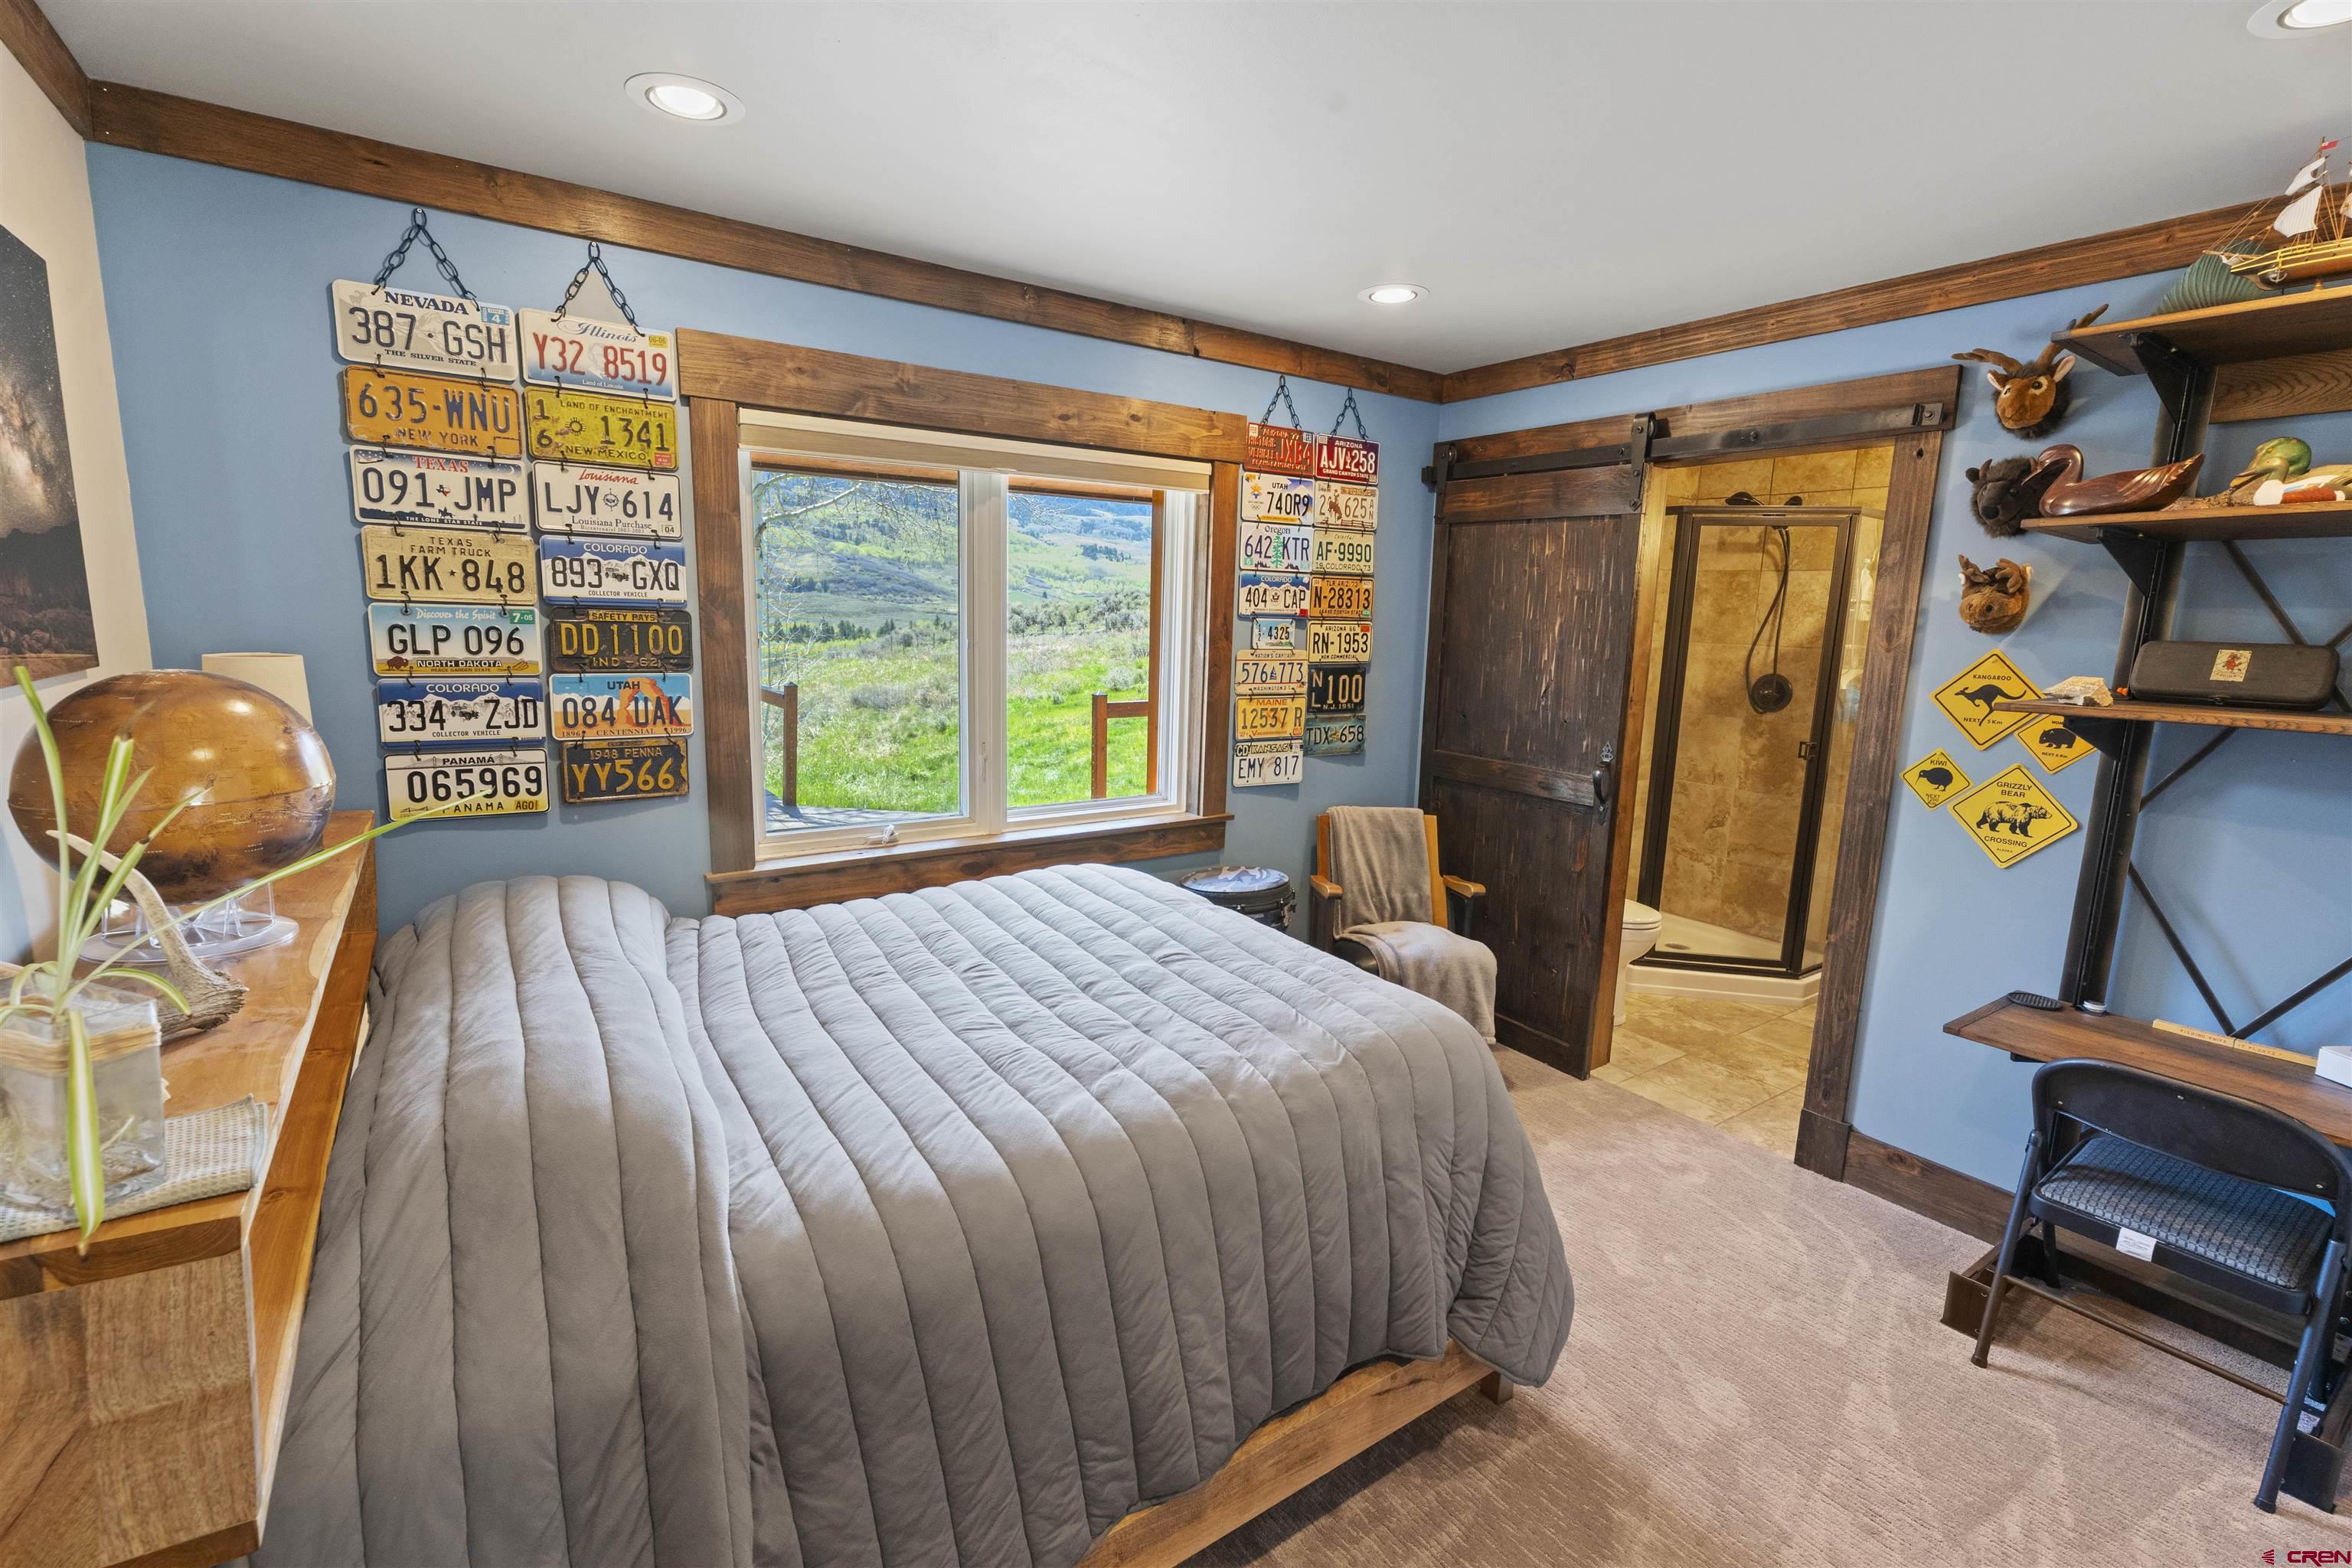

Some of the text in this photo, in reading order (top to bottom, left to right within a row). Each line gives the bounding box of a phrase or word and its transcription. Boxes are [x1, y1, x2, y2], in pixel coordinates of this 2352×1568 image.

[384, 291, 469, 315] NEVADA
[349, 306, 507, 363] 387 GSH
[557, 320, 638, 343] Illinois
[410, 353, 444, 361] SILVER
[448, 358, 477, 367] STATE
[533, 332, 667, 386] Y32 8519
[560, 400, 585, 410] LAND
[604, 405, 668, 419] ENCHANTMENT
[397, 428, 479, 446] NEW YORK
[600, 416, 671, 452] 1341
[1335, 440, 1363, 449] ARIZONA
[565, 446, 593, 456] NEW
[599, 448, 647, 460] MEXICO
[1320, 446, 1346, 470] AJV
[1351, 449, 1376, 473] 258
[413, 456, 469, 473] TEXAS
[579, 469, 639, 485] Louisiana
[362, 467, 517, 512] 091 JMP
[544, 482, 674, 521] LJY 614
[1344, 497, 1367, 518] 625
[571, 515, 652, 530] Louisiana Purchase
[1265, 525, 1291, 535] Oregon
[410, 544, 492, 557] FARM TRUCK
[430, 536, 472, 547] TEXAS
[583, 543, 648, 554] COLORADO
[1245, 534, 1309, 560] 642 KTR
[375, 554, 525, 593] 1KK 848
[550, 557, 680, 591] 893 GXQ
[1246, 587, 1305, 609] 404 CAP
[1314, 586, 1370, 609] N-28313
[416, 607, 496, 621] Discover the Spirit
[387, 623, 524, 655] GLP 096
[1268, 626, 1289, 640] 4325
[1312, 632, 1368, 654] RN-1953
[593, 657, 620, 667] IND
[1242, 662, 1303, 684] 576 773
[426, 684, 499, 692] COLORADO
[606, 681, 640, 690] UTAH
[1327, 675, 1363, 704] 100
[387, 699, 538, 731] 334 ZJD
[562, 695, 682, 728] 084 UAK
[1242, 707, 1302, 730] 12537 R
[1306, 724, 1364, 745] TDX 658
[443, 754, 495, 765] PANAMÁ
[590, 747, 662, 760] 1948 PENNA
[1236, 743, 1290, 756] CD KANSAS
[571, 757, 675, 792] YY566
[1238, 755, 1299, 779] EMY 817
[407, 766, 542, 803] 065969
[1996, 781, 2033, 791] GRIZZLY
[2001, 789, 2026, 798] BEAR
[1984, 835, 2027, 848] CROSSING
